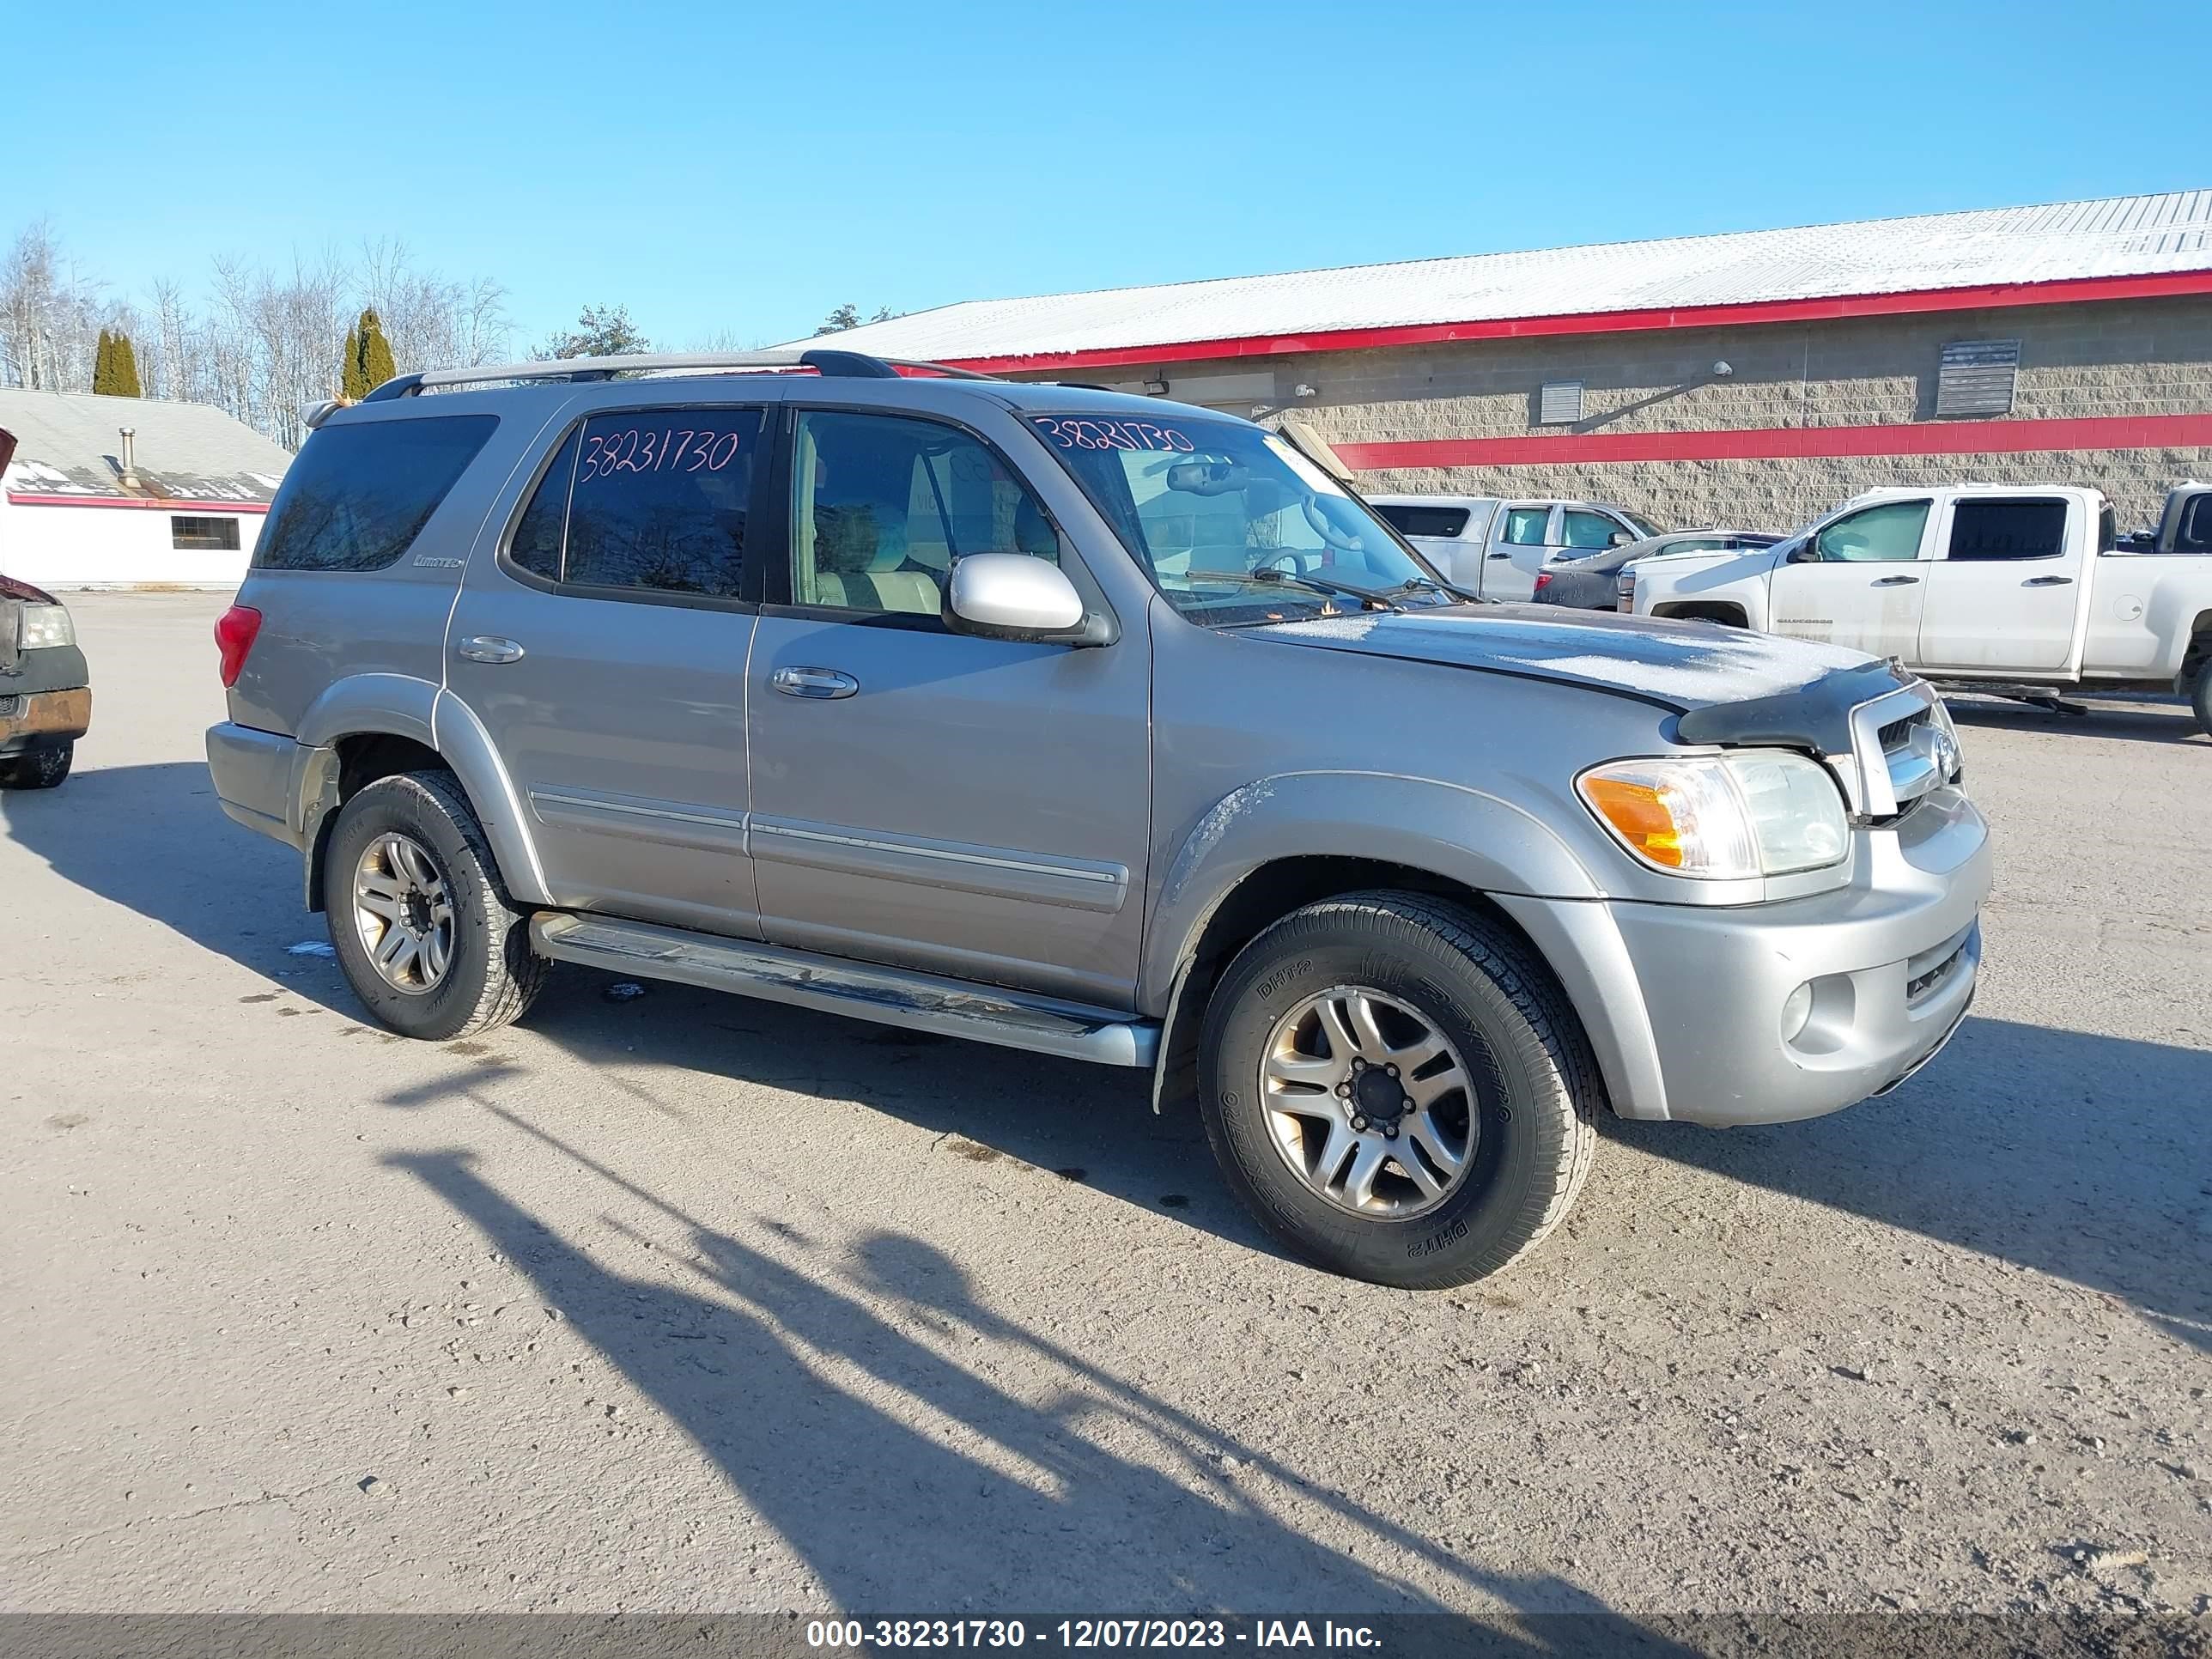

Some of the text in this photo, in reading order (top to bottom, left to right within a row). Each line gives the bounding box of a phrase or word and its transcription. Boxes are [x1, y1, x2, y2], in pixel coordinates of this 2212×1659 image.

[1035, 418, 1194, 452] 38231730
[580, 429, 738, 483] 38231730
[1256, 959, 1314, 1001] DHT2
[1407, 1218, 1470, 1258] DHT2
